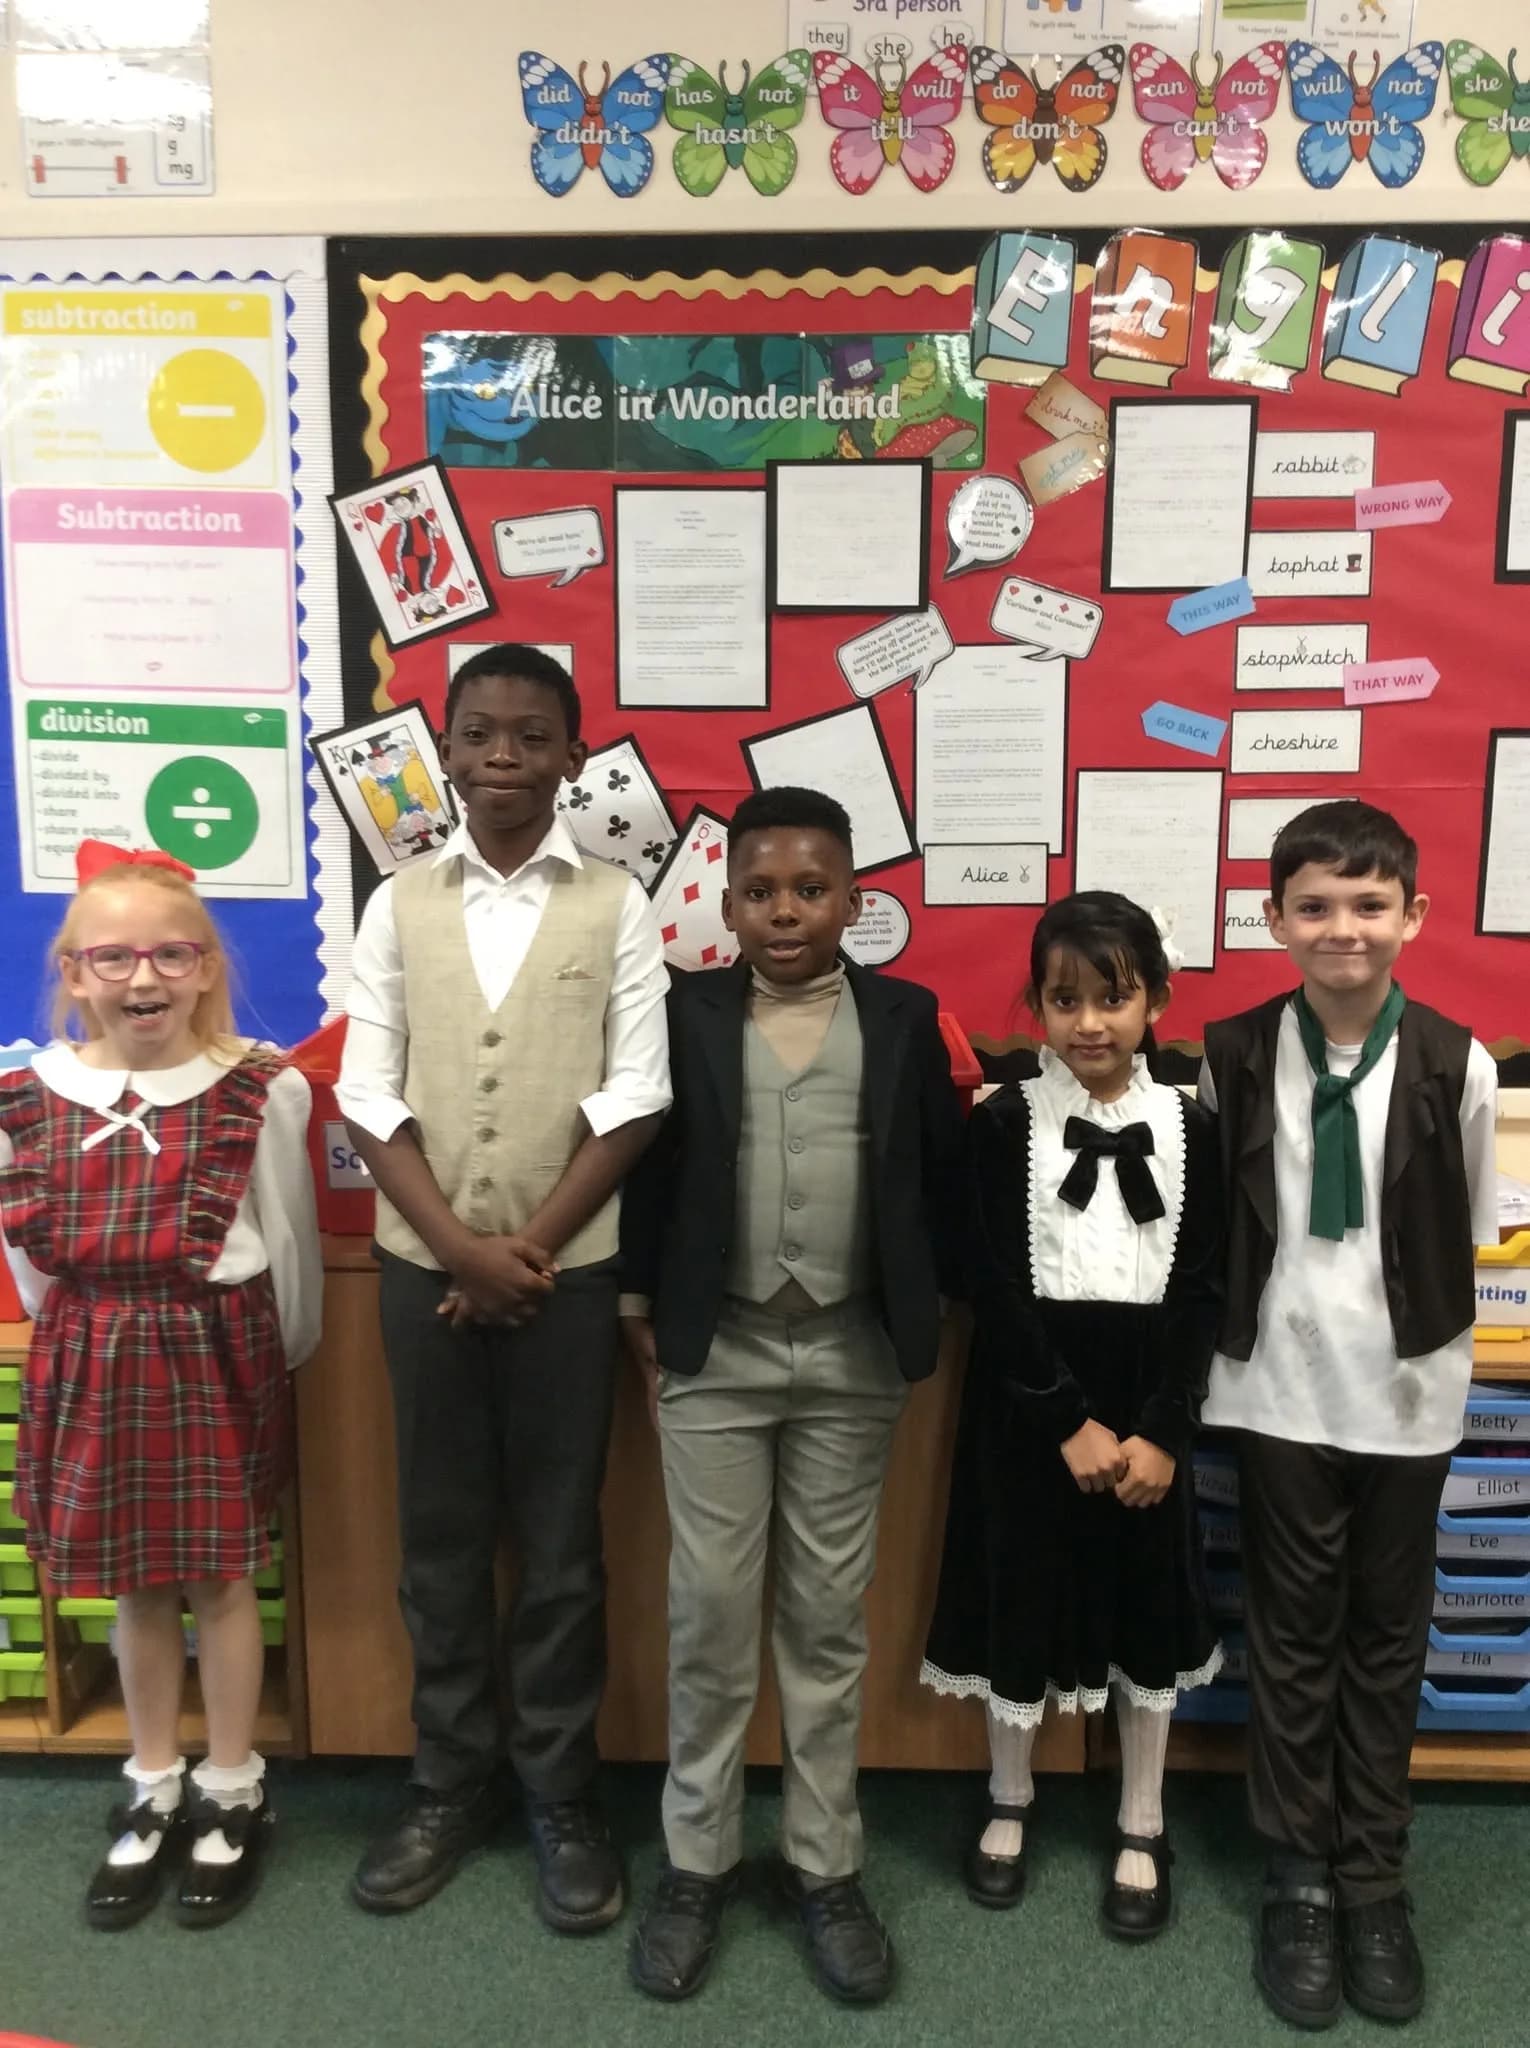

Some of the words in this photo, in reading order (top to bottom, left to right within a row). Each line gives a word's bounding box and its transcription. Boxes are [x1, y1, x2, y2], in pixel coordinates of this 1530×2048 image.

[896, 0, 962, 19] person
[808, 27, 844, 49] they
[874, 37, 906, 56] she
[943, 27, 966, 45] he
[843, 82, 861, 101] it
[912, 80, 956, 99] will
[992, 80, 1019, 99] do
[1070, 79, 1109, 99] not
[1145, 79, 1188, 96] can
[1230, 78, 1270, 96] not
[1302, 75, 1346, 96] will
[1387, 77, 1427, 97] not
[1464, 73, 1503, 94] she
[537, 86, 572, 104] did
[617, 90, 652, 107] not
[675, 88, 714, 106] has
[758, 87, 793, 104] not
[556, 122, 633, 145] didn't
[695, 122, 782, 145] hasn't
[869, 120, 917, 142] it'll
[1012, 117, 1083, 140] don't
[1173, 113, 1240, 137] can't
[1325, 111, 1402, 137] won't
[169, 163, 194, 180] mg
[21, 302, 197, 330] subtraction
[509, 384, 602, 420] Alice
[619, 385, 656, 421] in
[668, 384, 901, 422] Wonderland
[1272, 455, 1339, 475] rabbit
[1360, 499, 1410, 516] WRONG
[1415, 495, 1444, 510] WAY
[57, 502, 243, 532] Subtraction
[1267, 555, 1340, 579] tophat
[1180, 606, 1211, 622] THIS
[1213, 595, 1241, 612] WAY
[1242, 648, 1357, 672] stopwatch
[1352, 676, 1388, 691] THAT
[1392, 673, 1425, 687] WAY
[40, 707, 149, 735] division
[1156, 716, 1175, 731] GO
[1178, 721, 1210, 741] BACK
[1250, 733, 1339, 751] cheshire
[961, 866, 1009, 883] Alice
[331, 1146, 362, 1170] Sc
[1476, 1285, 1527, 1305] iting
[1471, 1414, 1519, 1432] Betty
[1477, 1479, 1521, 1496] Elliot
[1469, 1533, 1499, 1549] Eve
[1443, 1592, 1525, 1607] Charlotte
[1461, 1651, 1491, 1665] Ella
